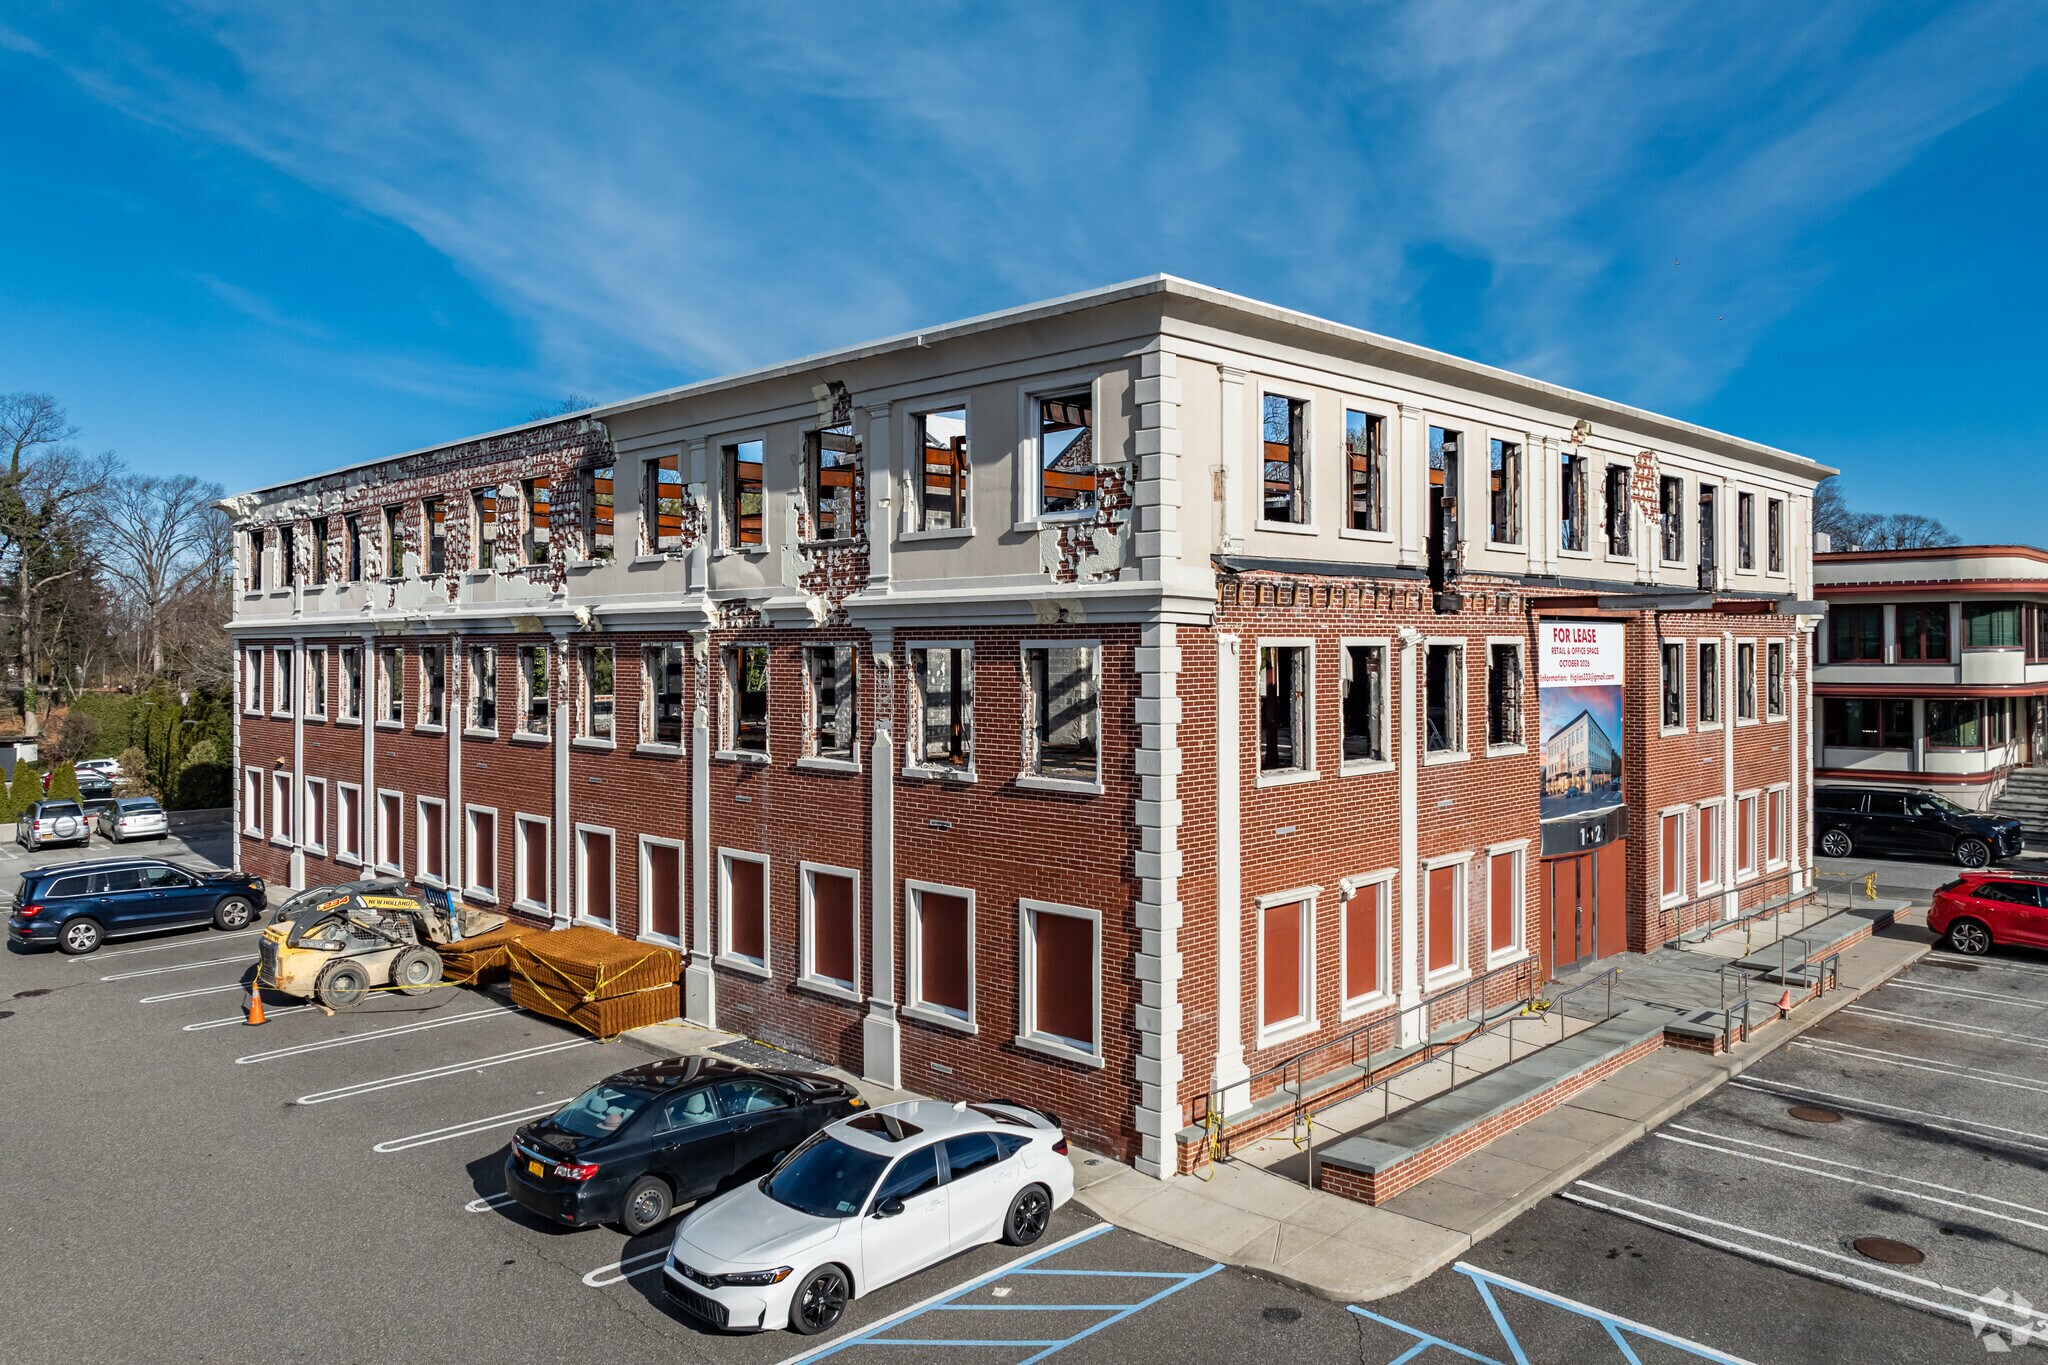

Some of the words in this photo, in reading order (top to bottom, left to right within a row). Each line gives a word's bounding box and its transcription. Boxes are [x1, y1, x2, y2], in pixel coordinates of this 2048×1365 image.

[1553, 628, 1571, 643] FOR
[1573, 628, 1597, 643] LEASE
[383, 899, 411, 907] HOLLAND
